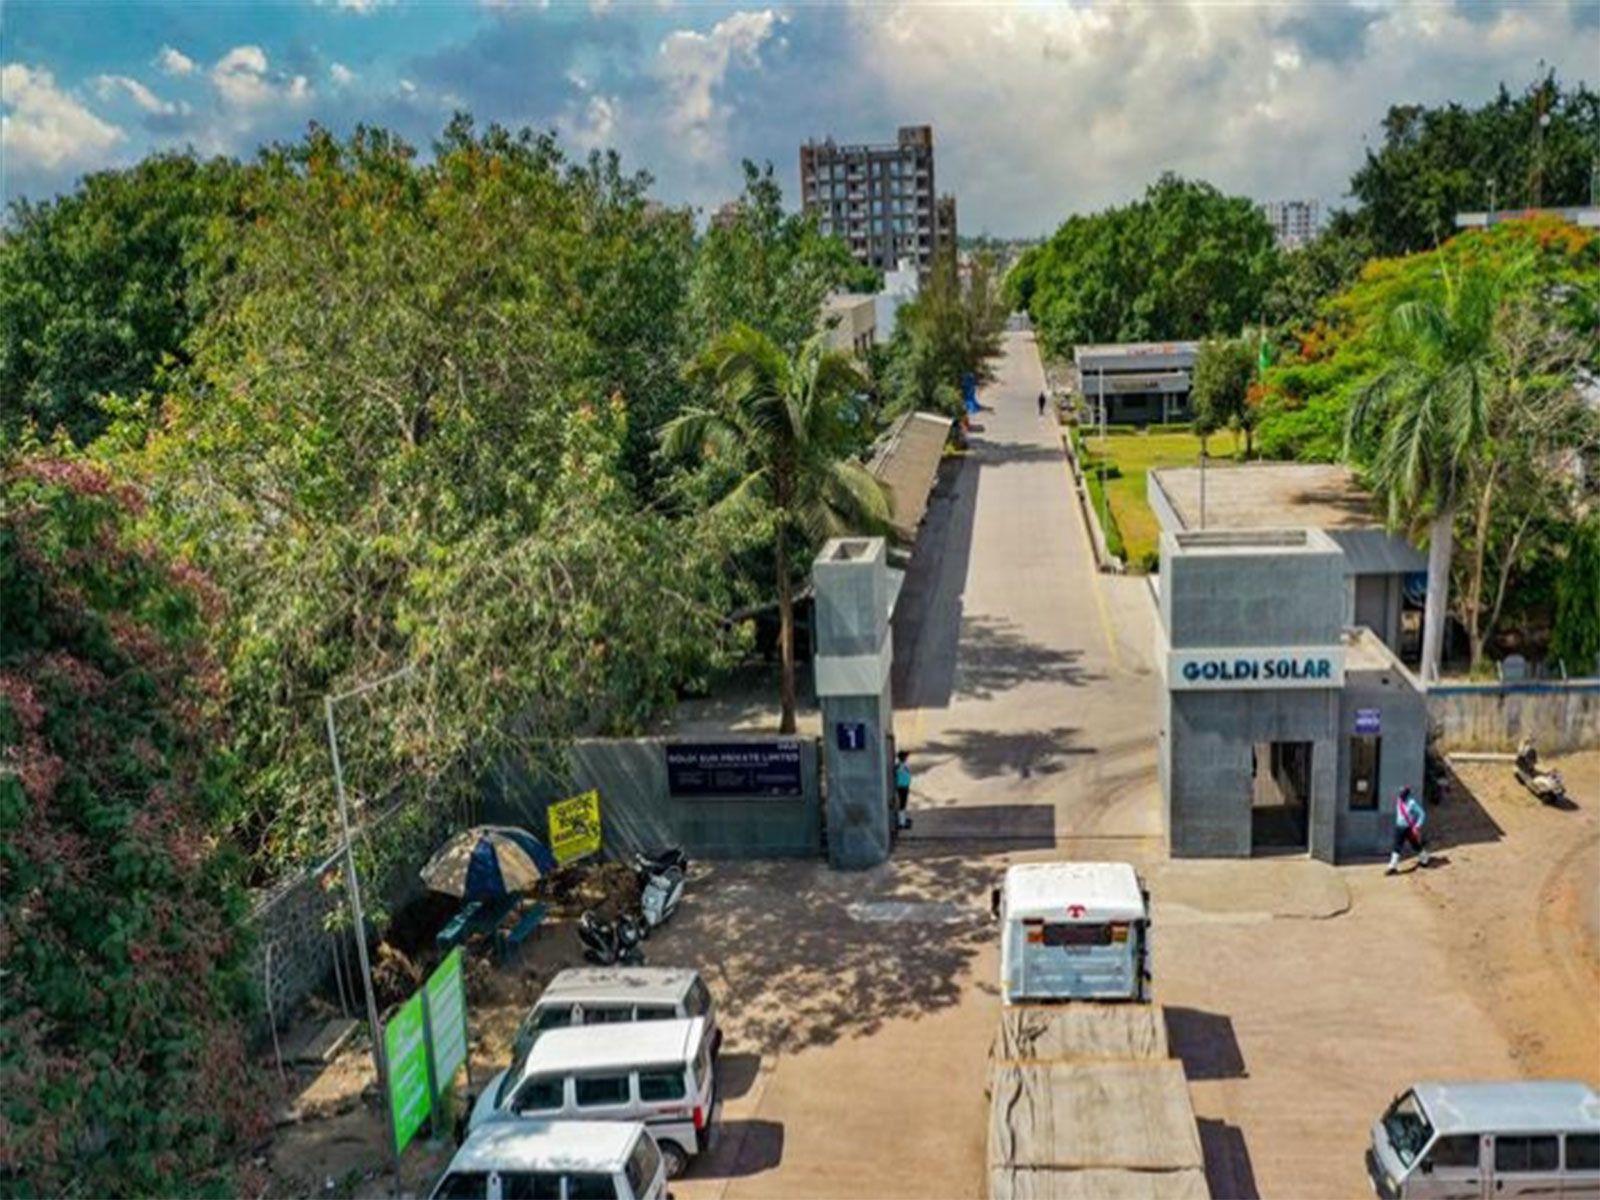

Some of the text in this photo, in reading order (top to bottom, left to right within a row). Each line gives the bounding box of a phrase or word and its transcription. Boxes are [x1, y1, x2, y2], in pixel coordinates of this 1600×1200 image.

[1183, 658, 1331, 681] GOLDI SOLAR
[847, 730, 856, 748] 1
